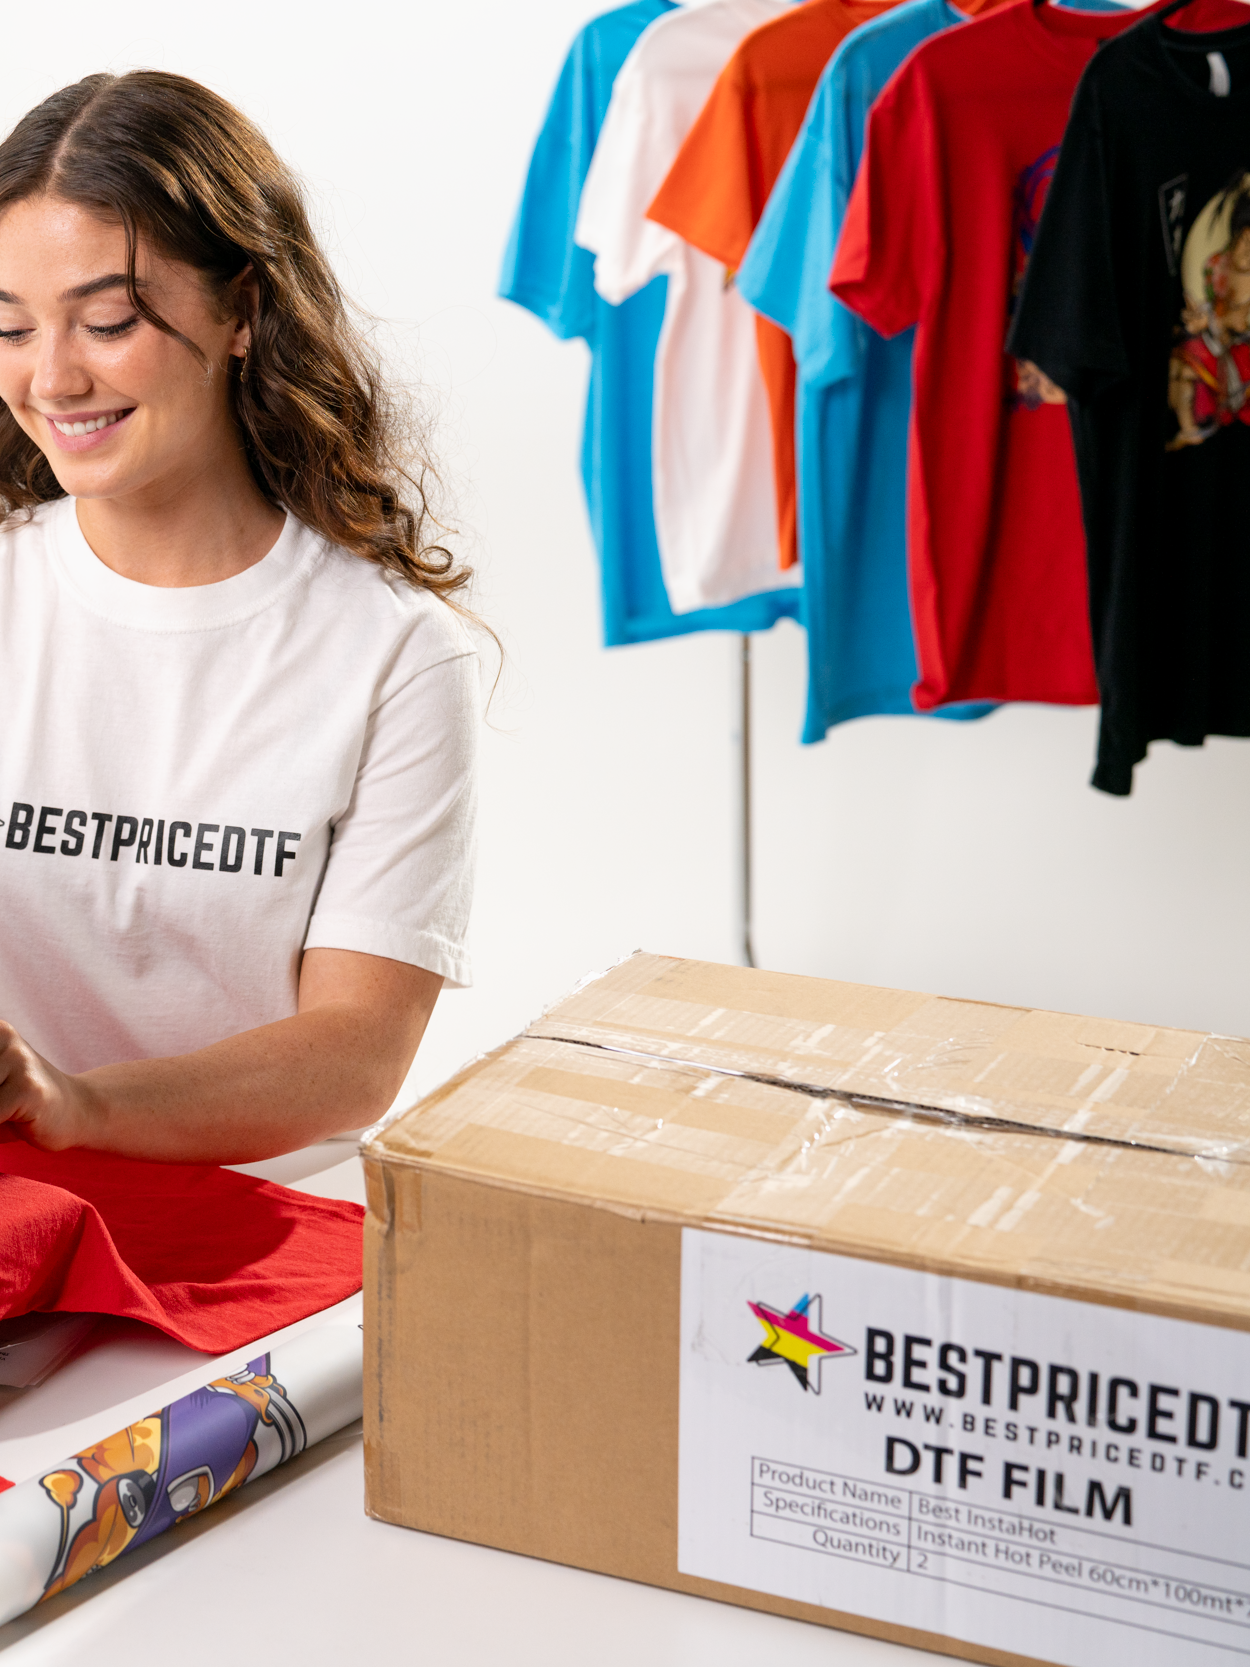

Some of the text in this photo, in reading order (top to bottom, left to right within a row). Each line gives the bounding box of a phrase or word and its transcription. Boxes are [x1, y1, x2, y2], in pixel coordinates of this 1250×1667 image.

[5, 801, 302, 877] BESTPRICEDTF
[864, 1325, 1250, 1460] BESTPRICEDT
[758, 1462, 902, 1510] Product Name
[884, 1435, 1133, 1527] DTF FILM
[762, 1490, 901, 1537] Specifications
[918, 1497, 1057, 1546] Best InstaHot
[812, 1527, 901, 1568] Quantity
[916, 1551, 929, 1571] 2
[917, 1524, 1250, 1618] Instant Hot Peel 60cm100mt
